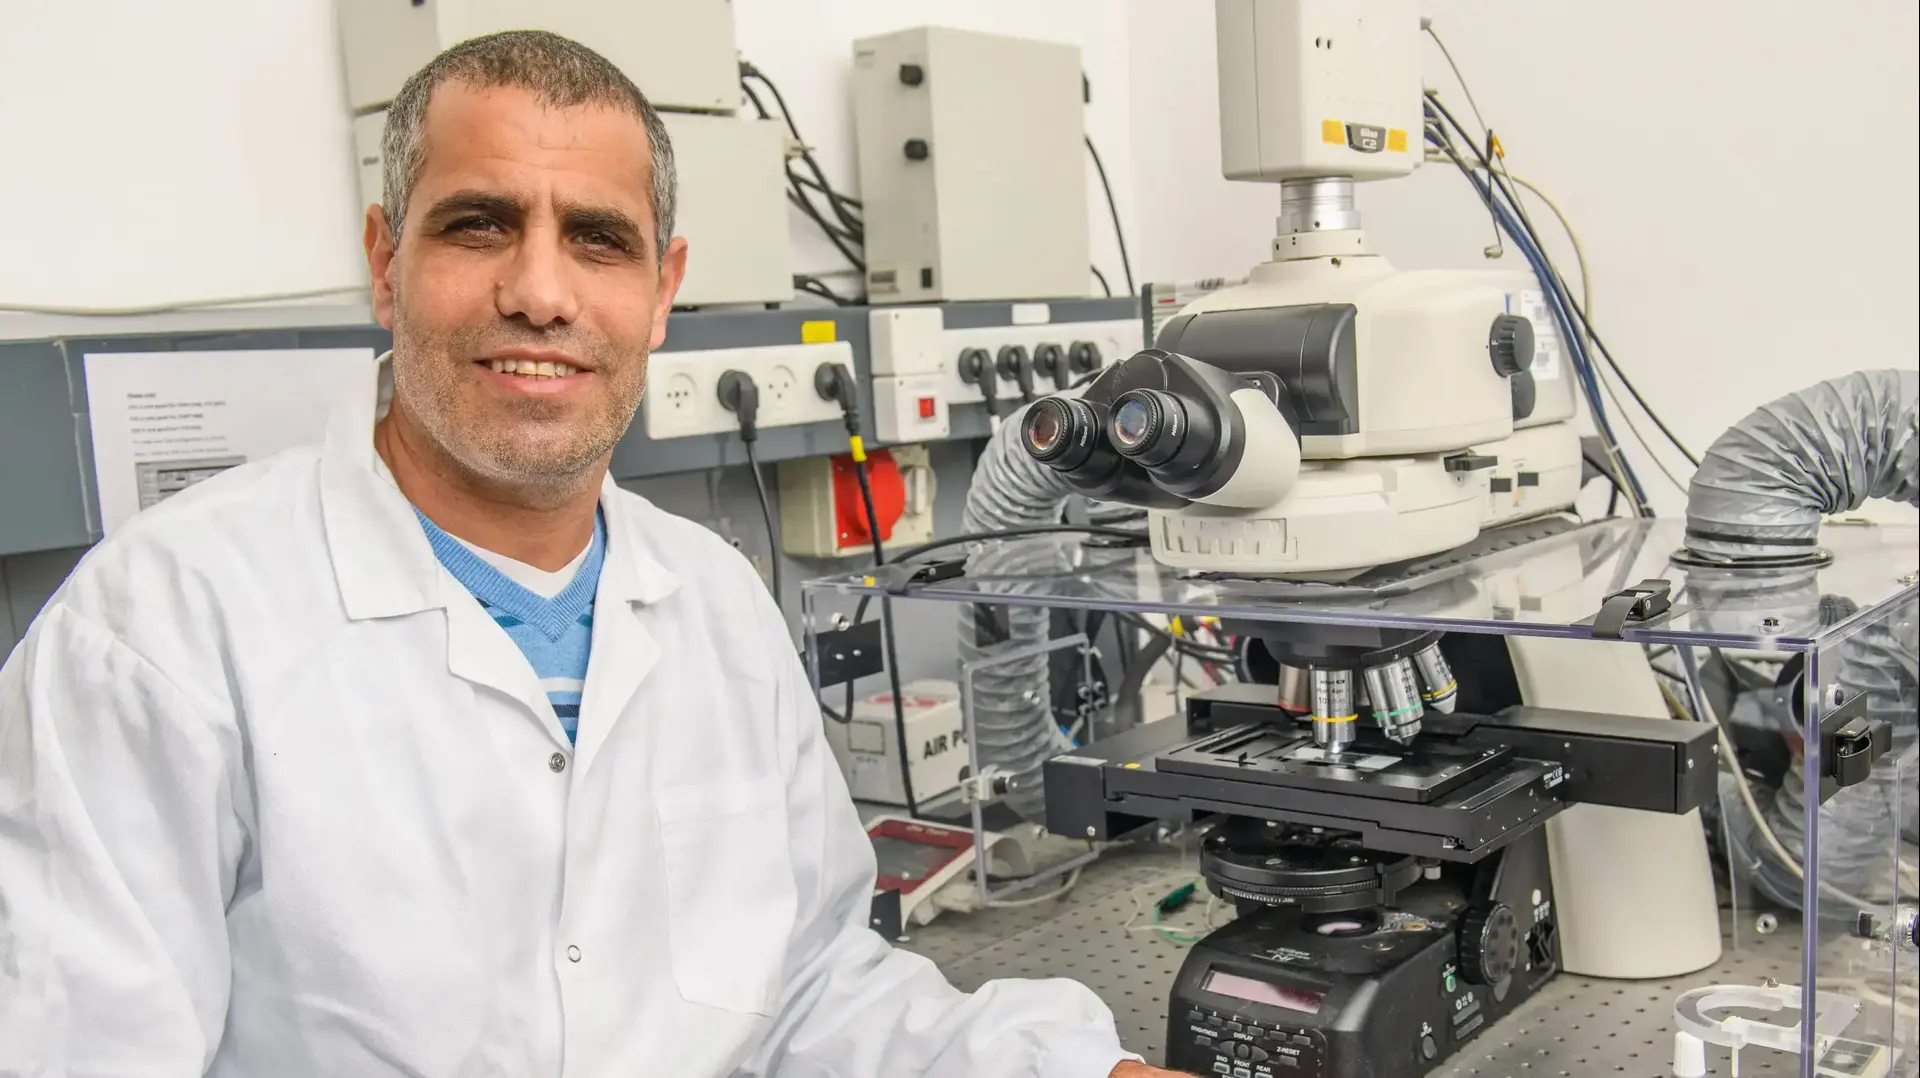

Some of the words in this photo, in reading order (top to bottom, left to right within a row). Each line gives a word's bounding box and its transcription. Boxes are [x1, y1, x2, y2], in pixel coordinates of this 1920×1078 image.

[1080, 425, 1088, 447] Nikon
[923, 735, 948, 760] AIR
[1233, 1031, 1254, 1041] DISPLAY
[1276, 1046, 1300, 1056] Z-RESET
[1233, 1060, 1250, 1069] FRONT
[1256, 1064, 1271, 1073] REAR
